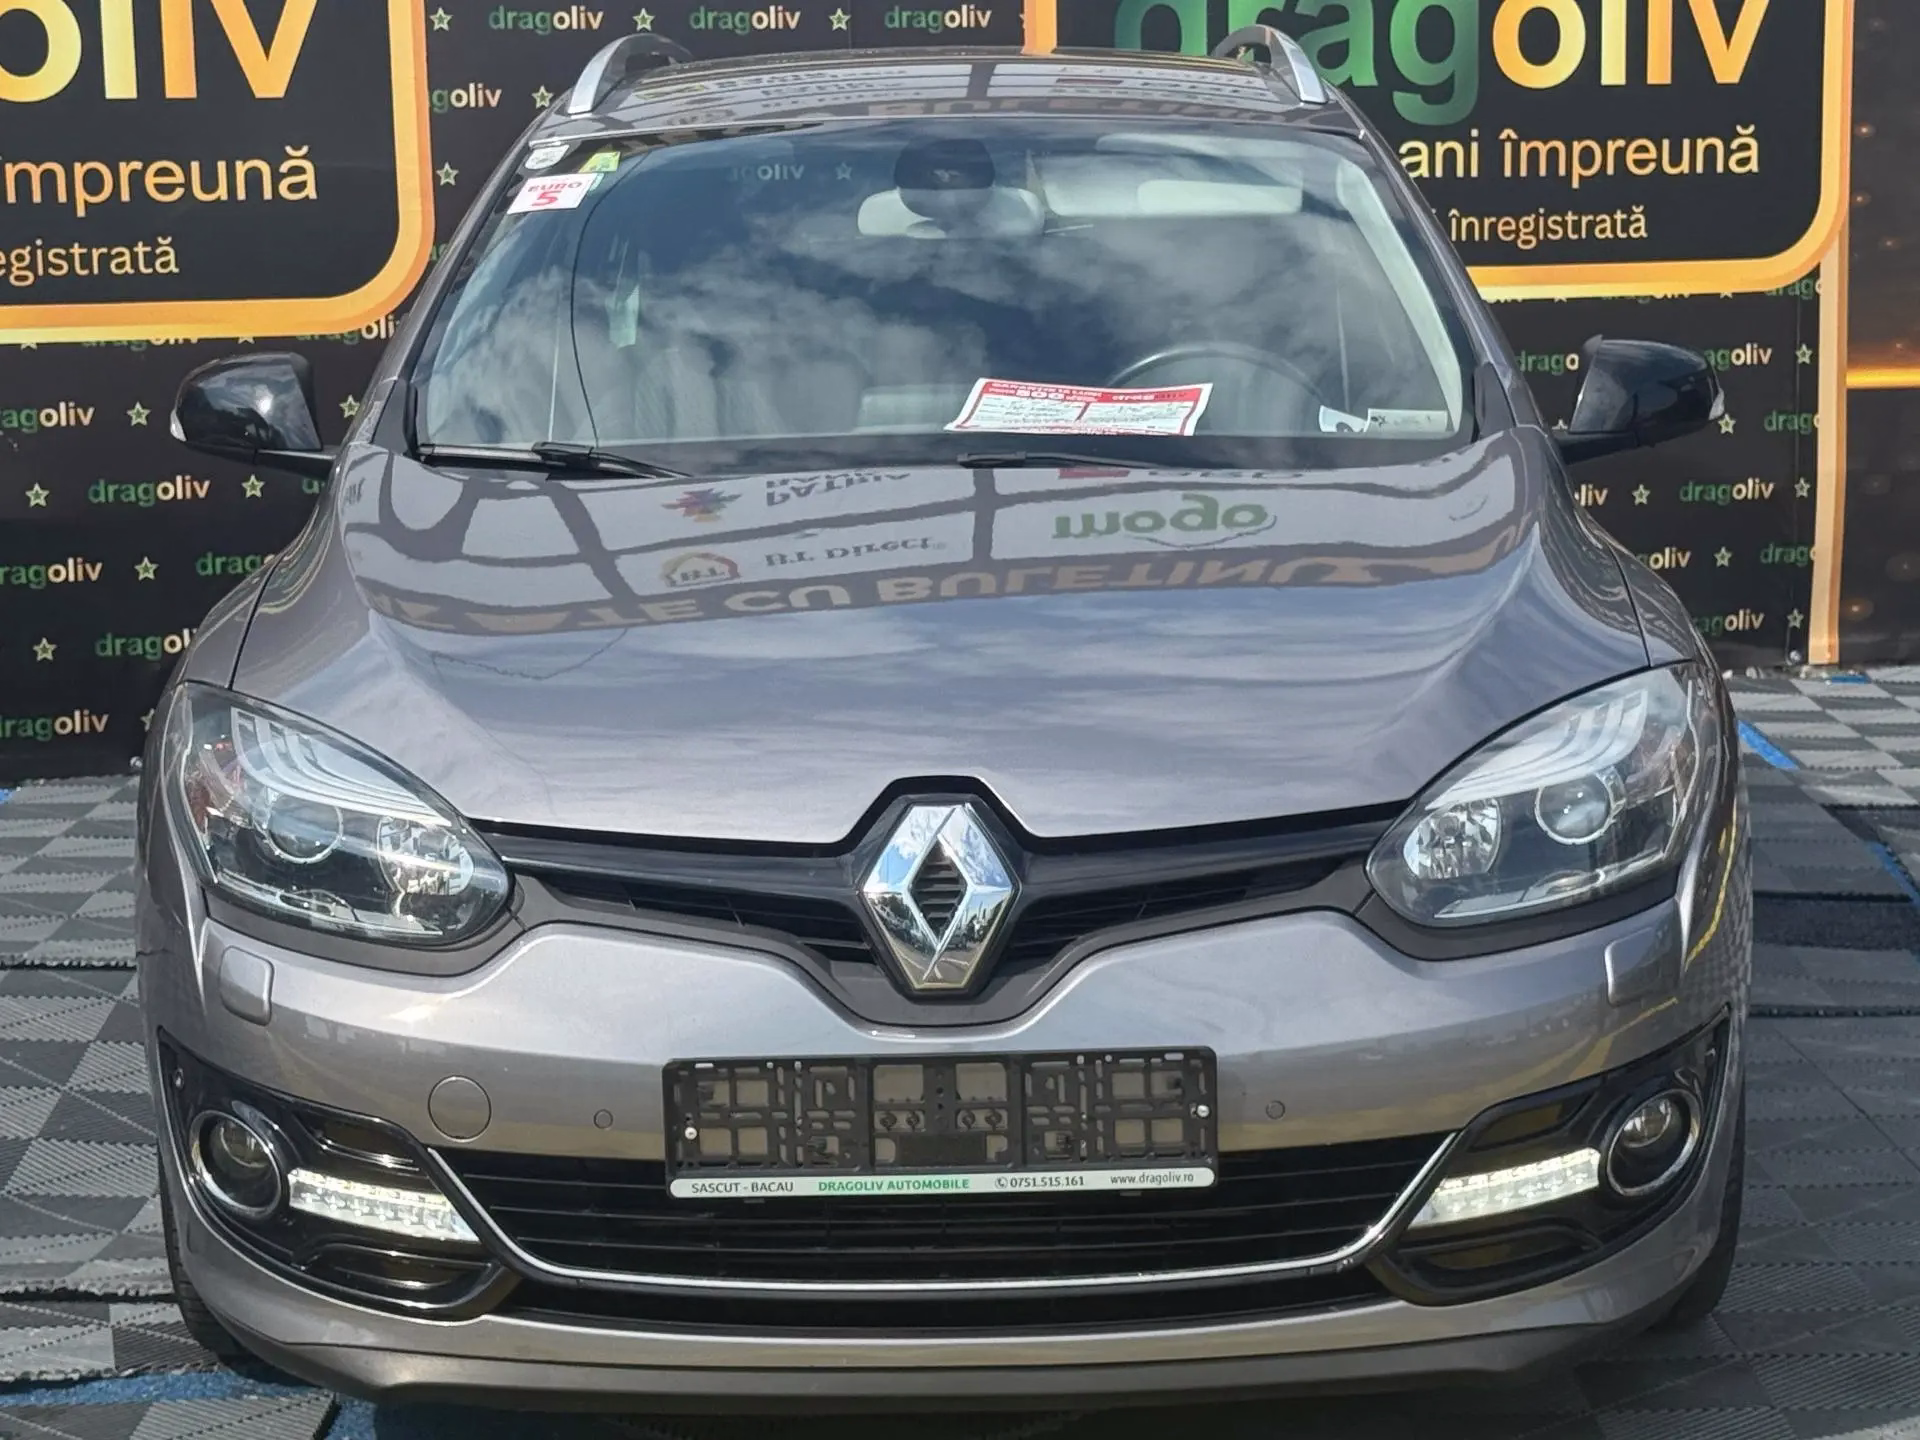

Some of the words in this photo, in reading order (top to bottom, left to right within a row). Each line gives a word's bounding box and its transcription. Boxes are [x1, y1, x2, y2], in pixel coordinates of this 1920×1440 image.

[489, 4, 603, 34] dragoliv
[690, 4, 801, 33] dragoliv
[885, 4, 992, 31] dragoliv
[1399, 128, 1479, 178] ani
[1498, 124, 1759, 189] împreună
[0, 145, 318, 218] mpreună
[527, 182, 582, 193] EURO
[531, 190, 562, 207] 5
[1448, 204, 1648, 250] înregistrată
[0, 401, 95, 434] agoliv
[88, 475, 212, 507] dragoliv
[1679, 477, 1775, 506] dragoliv
[1692, 608, 1765, 637] agoliv
[95, 628, 198, 662] dragol
[0, 709, 109, 742] ragoliv
[691, 1182, 741, 1194] SASCUT
[751, 1181, 794, 1193] BACAU
[818, 1180, 883, 1192] DRAGOLIV
[886, 1178, 969, 1191] AUTOMOBILE
[1110, 1170, 1195, 1186] www.dragoliv.ro
